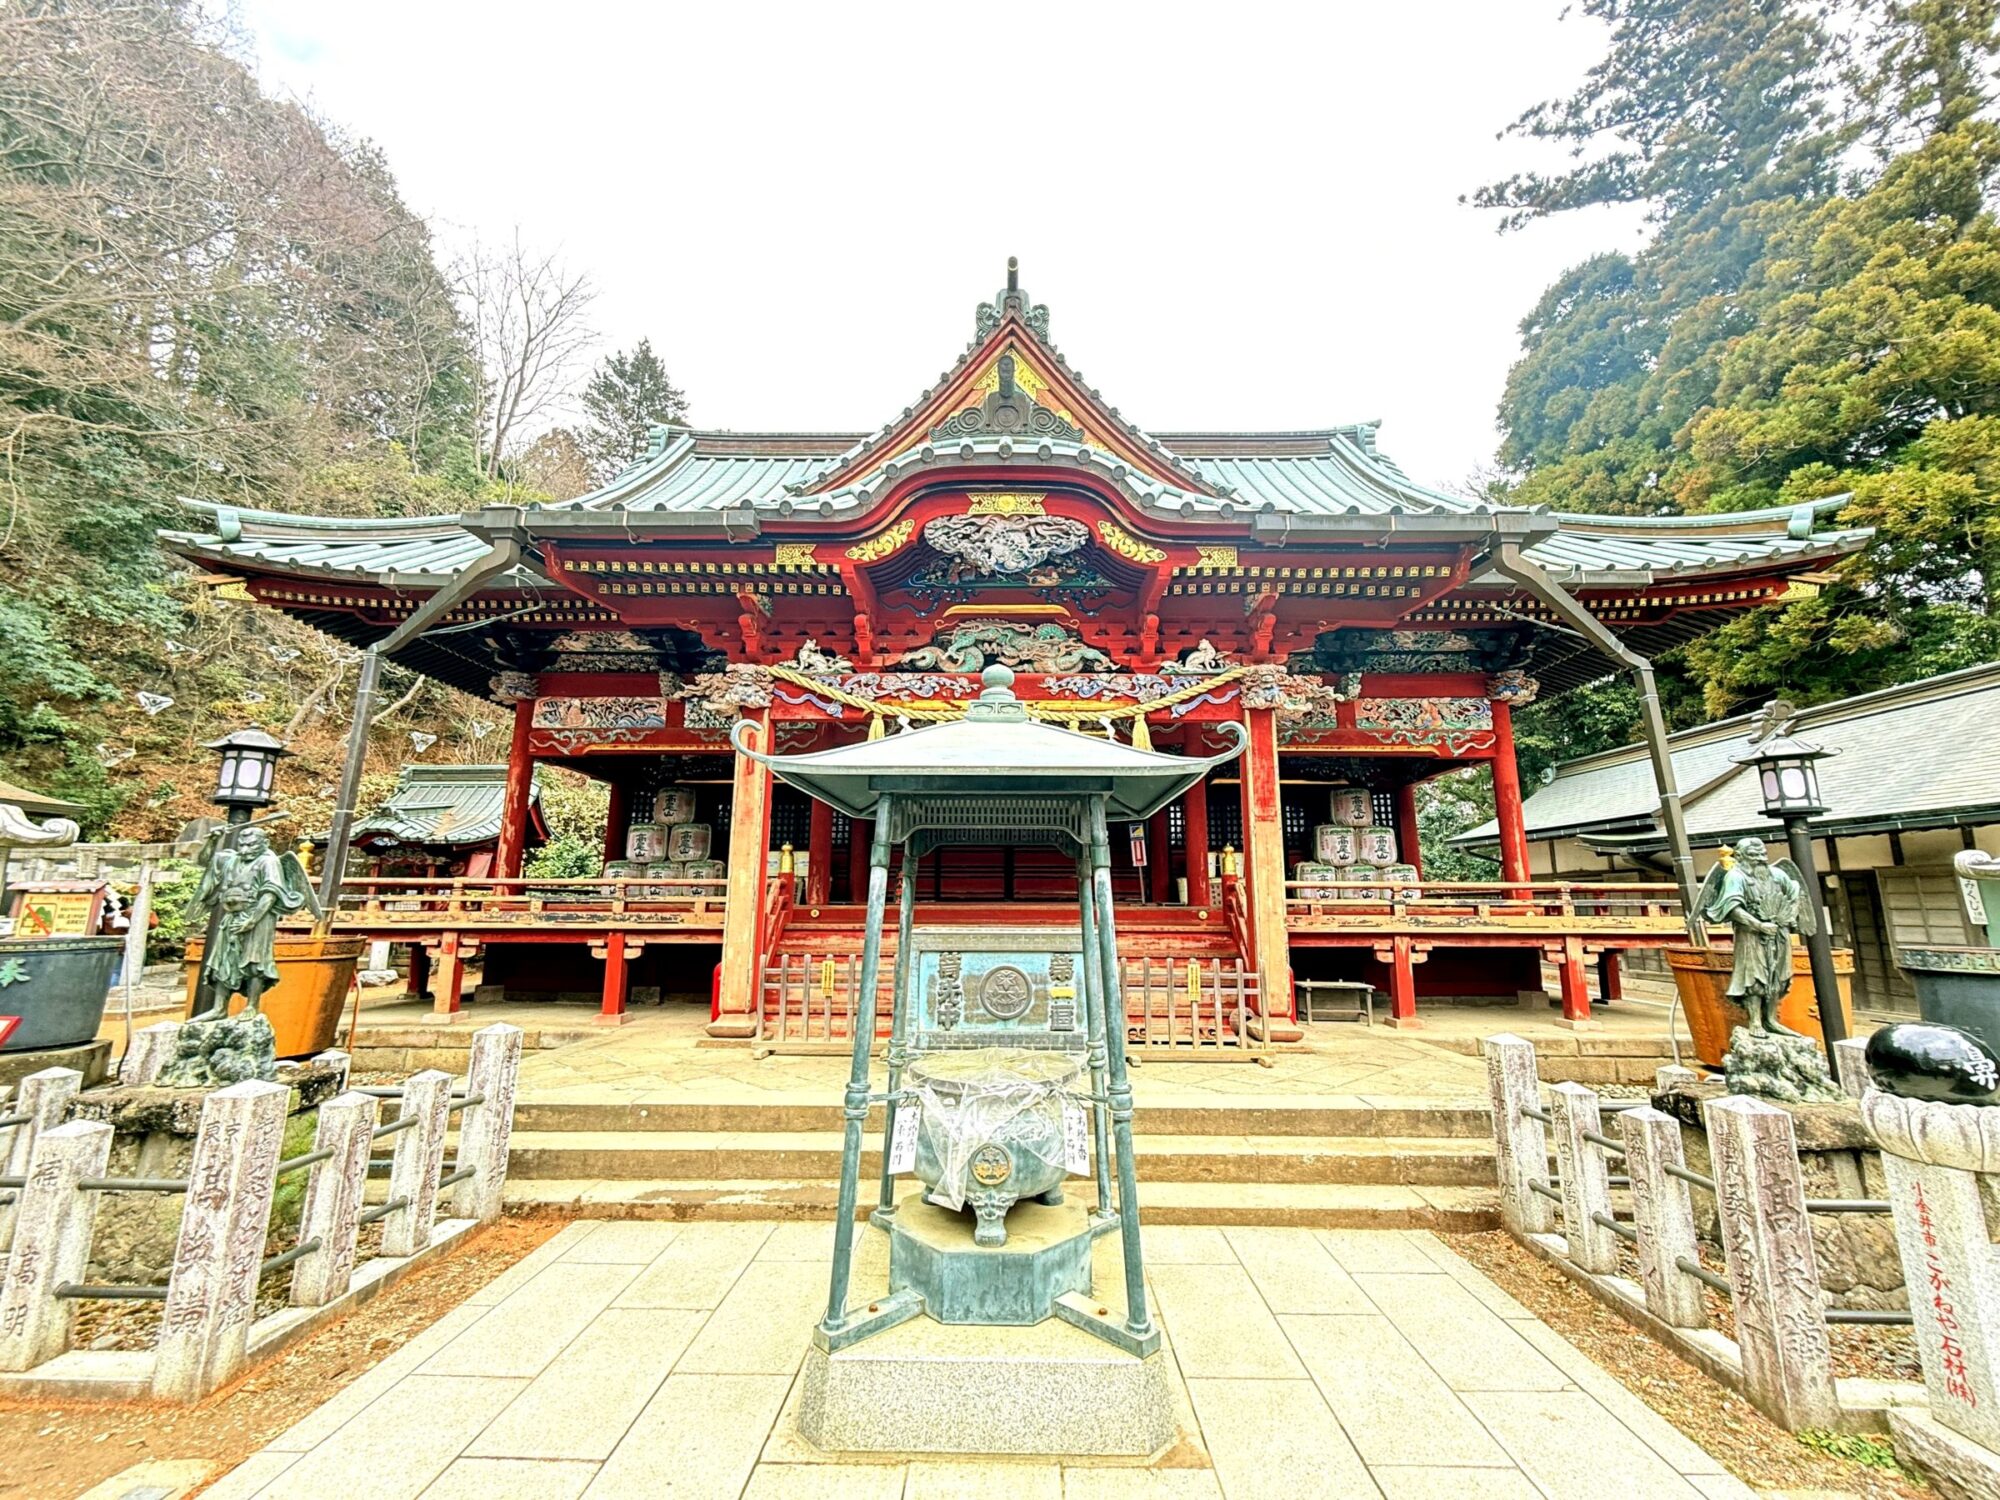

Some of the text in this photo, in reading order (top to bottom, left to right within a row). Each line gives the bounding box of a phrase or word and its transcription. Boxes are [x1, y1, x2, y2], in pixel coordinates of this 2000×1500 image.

[1351, 796, 1366, 819] 高尾山
[634, 833, 648, 857] 高尾山
[1337, 835, 1351, 860] 高尾山
[1375, 835, 1390, 860] 高尾山
[204, 1119, 241, 1144] 東京
[1753, 1135, 1793, 1164] 東京
